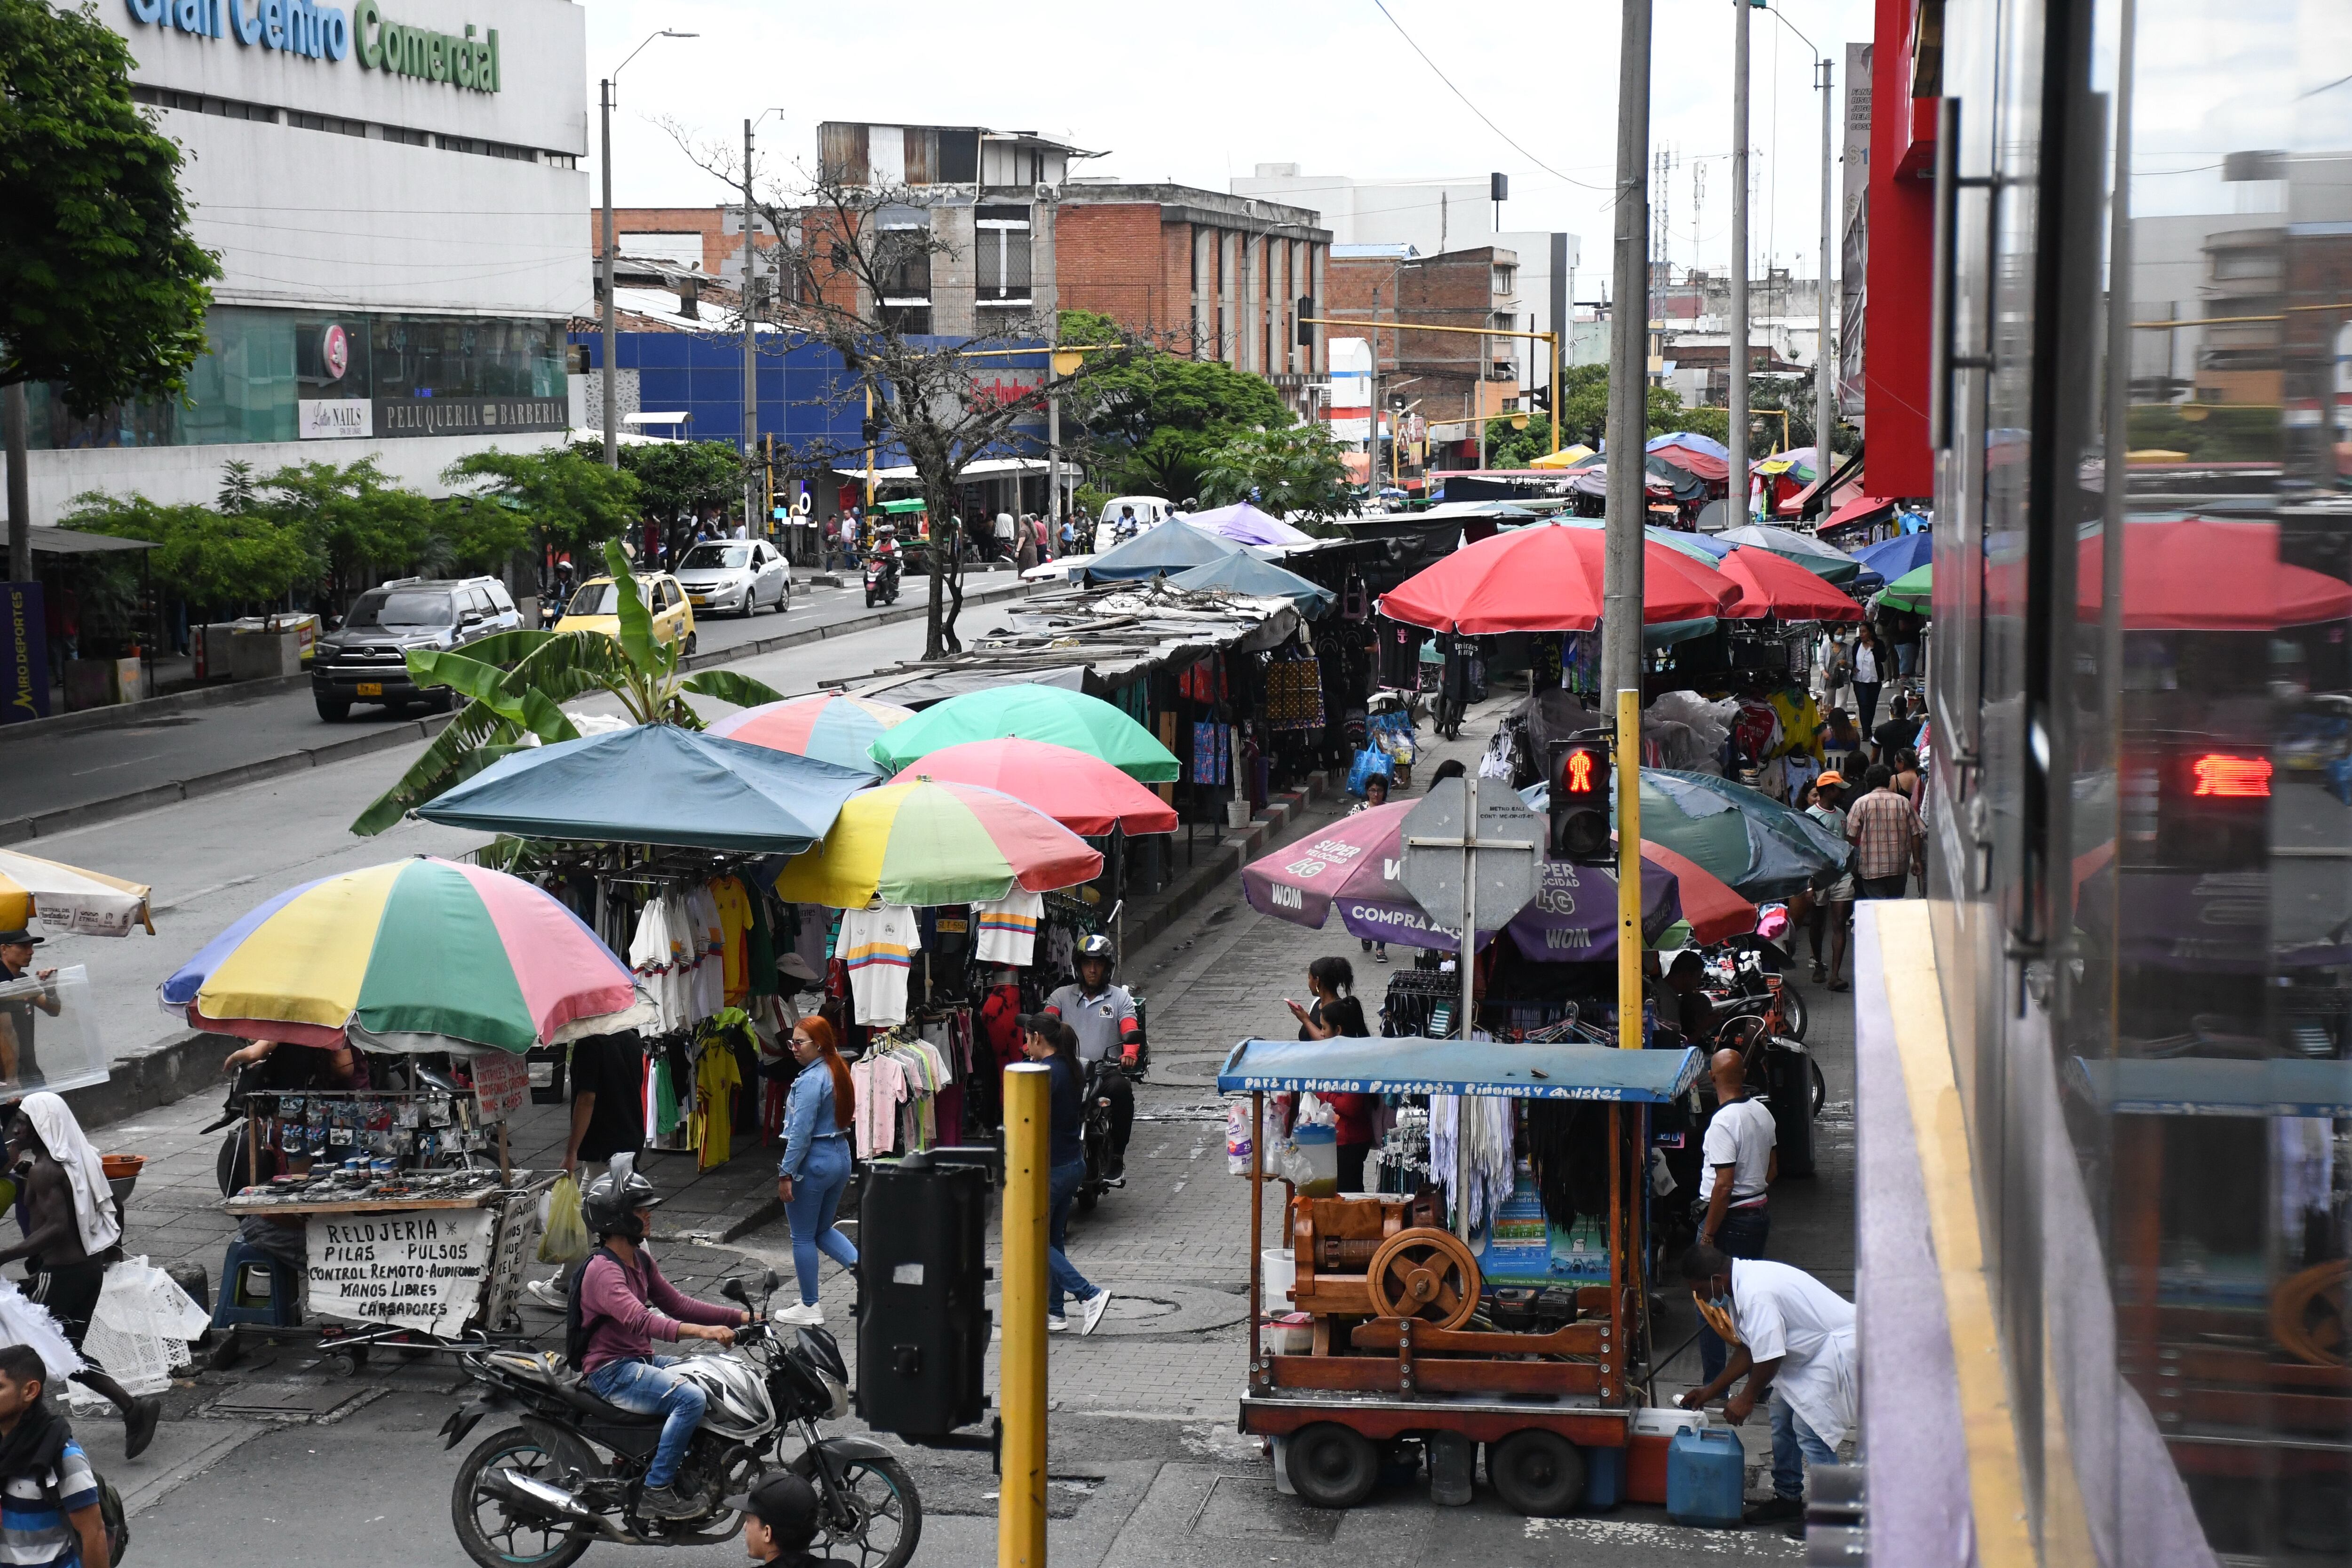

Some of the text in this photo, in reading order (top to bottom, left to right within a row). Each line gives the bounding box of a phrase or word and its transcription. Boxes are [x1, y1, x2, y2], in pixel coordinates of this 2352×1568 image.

[231, 0, 348, 61] Centro
[354, 0, 501, 93] Comercial
[333, 407, 361, 426] NAILS
[387, 403, 564, 433] PELUQUERIA BARBERIA
[12, 591, 27, 663] DEPORTES
[1305, 848, 1347, 864] VELOCIDAD
[1315, 840, 1361, 858] SÚPER
[1285, 858, 1326, 878] 4G
[1543, 864, 1576, 877] PER
[1272, 883, 1302, 909] WOM
[1536, 888, 1575, 915] 4G
[1352, 906, 1426, 930] COMPRA
[1546, 928, 1592, 948] WOM
[326, 1218, 437, 1244] RELOJERIA
[325, 1243, 468, 1261] PILAS PULSOS
[310, 1266, 367, 1281] CONTROL
[370, 1263, 423, 1279] REMOTO
[340, 1281, 437, 1297] MANOS LIBRES
